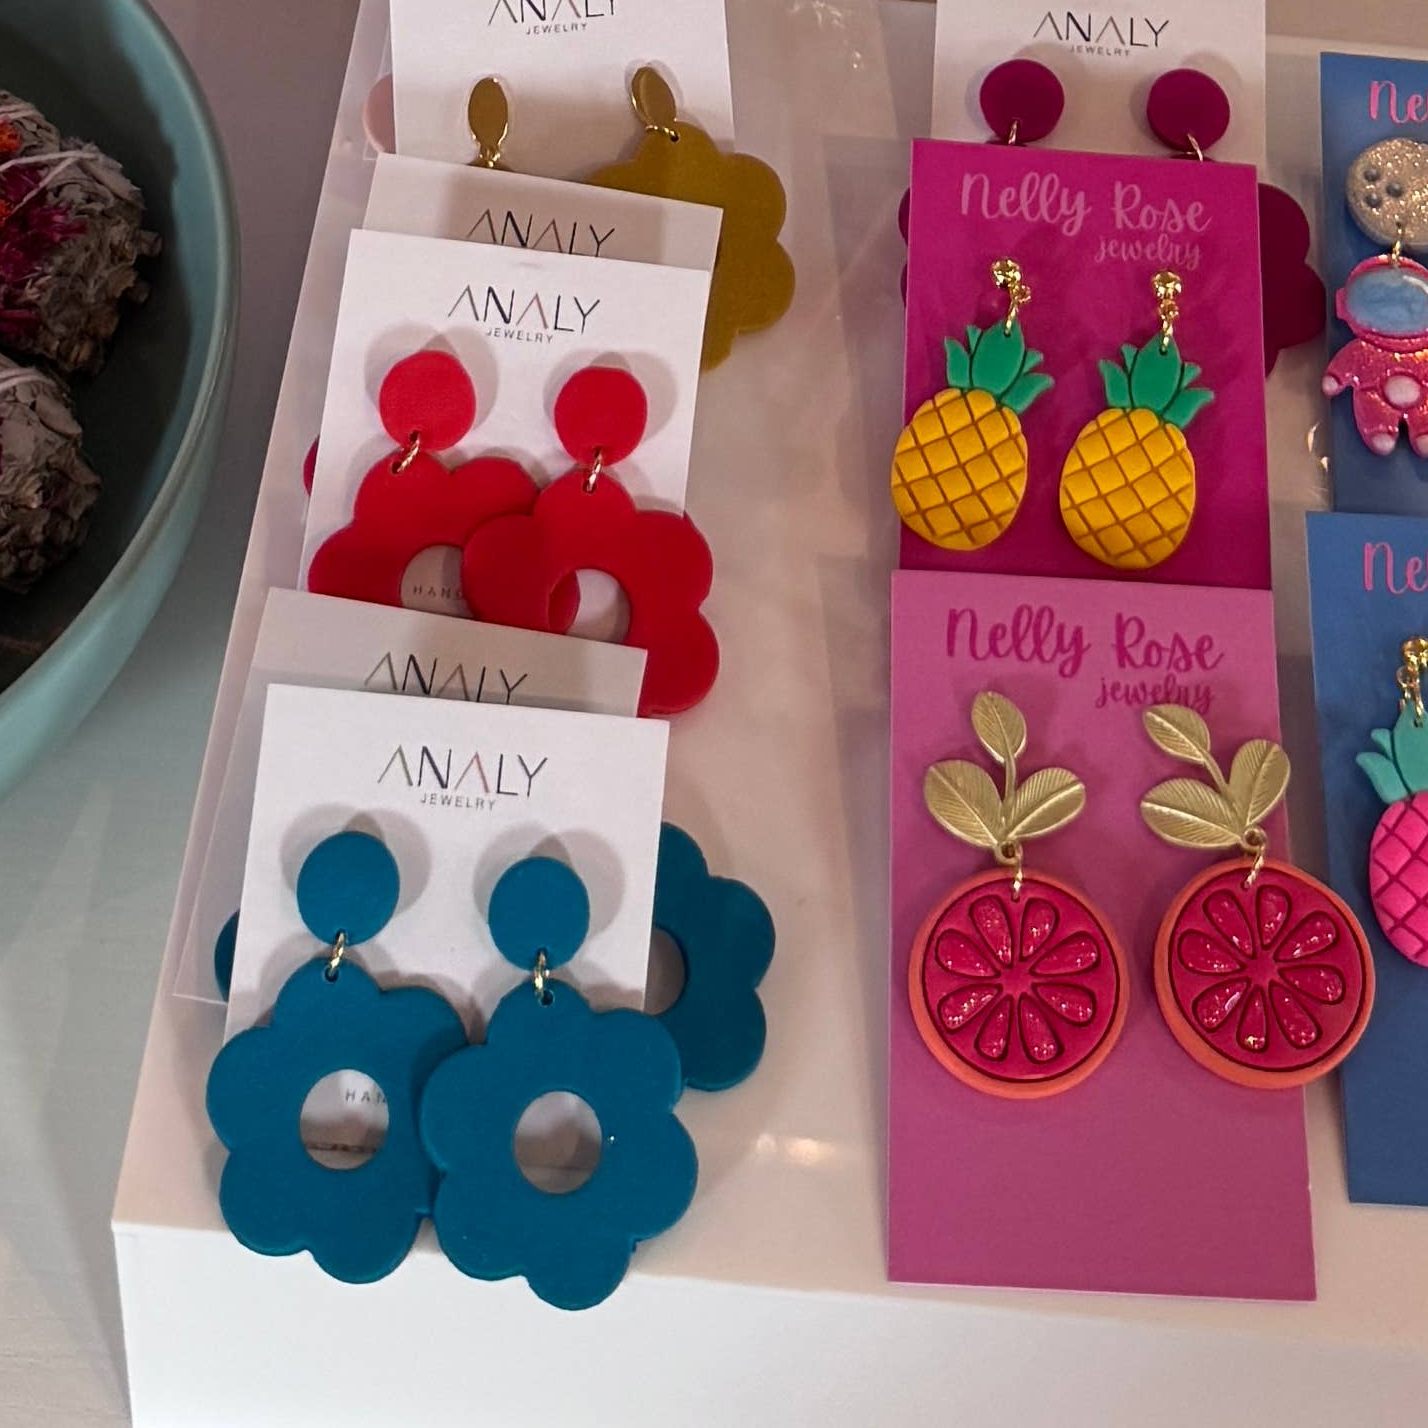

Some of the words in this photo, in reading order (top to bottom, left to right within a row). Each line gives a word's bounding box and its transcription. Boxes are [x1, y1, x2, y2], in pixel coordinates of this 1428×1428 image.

[525, 22, 588, 36] JEWELRY
[1033, 10, 1171, 48] ANALY
[1070, 44, 1131, 58] JEWELRY
[960, 170, 1092, 237] Nelly
[1110, 180, 1212, 234] Rose
[1093, 232, 1202, 270] jewelry
[447, 284, 601, 335] ANALY
[485, 326, 555, 345] JEWELRY
[945, 603, 1091, 679] Nelly
[1112, 610, 1225, 674] Rose
[1094, 672, 1217, 716] jewelry
[377, 744, 548, 798] ANALY
[419, 792, 497, 812] JEWELRY
